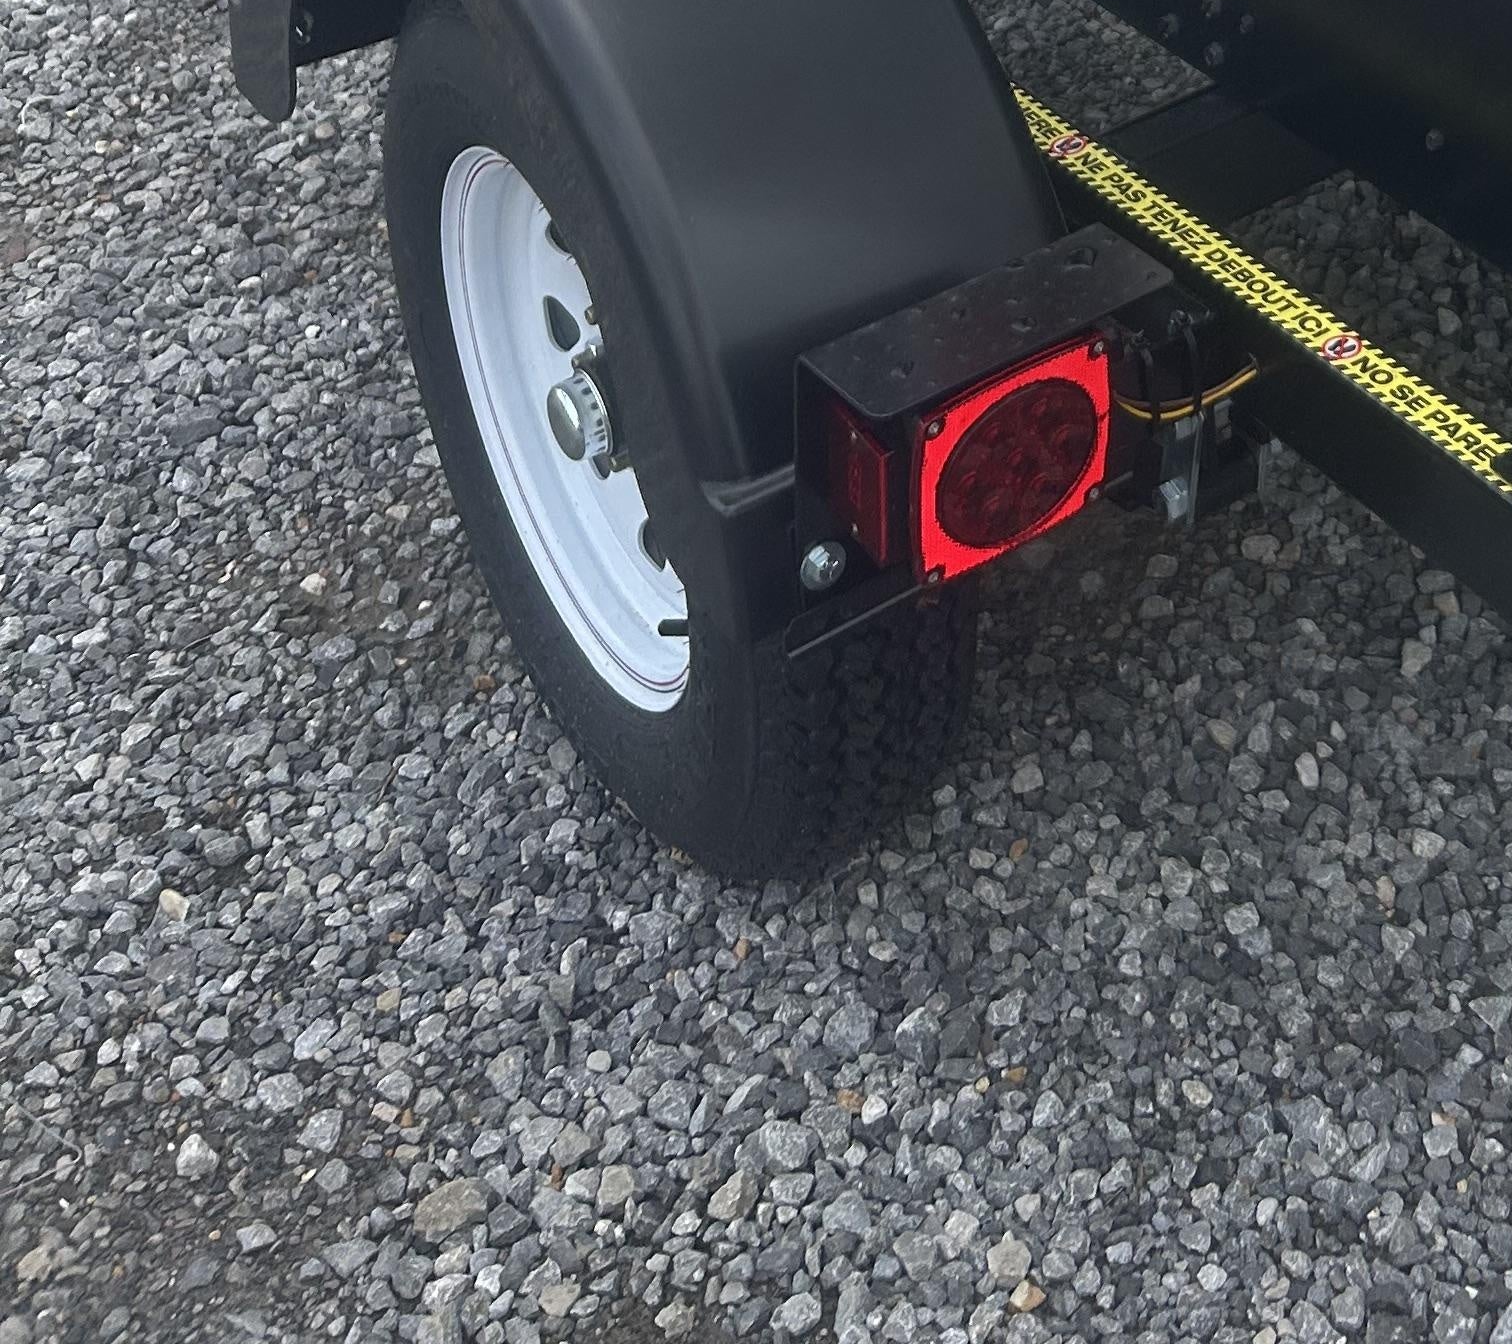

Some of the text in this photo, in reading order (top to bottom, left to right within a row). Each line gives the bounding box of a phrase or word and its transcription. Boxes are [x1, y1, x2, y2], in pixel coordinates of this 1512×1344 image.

[1073, 150, 1110, 176] NE
[1101, 172, 1148, 204] PAS
[1142, 198, 1214, 252] TENEZ
[1202, 246, 1300, 316] DEBOUT
[1293, 310, 1331, 339] ICI
[1351, 354, 1395, 386] NO
[1389, 383, 1432, 413] SE
[1424, 408, 1499, 462] PARE
